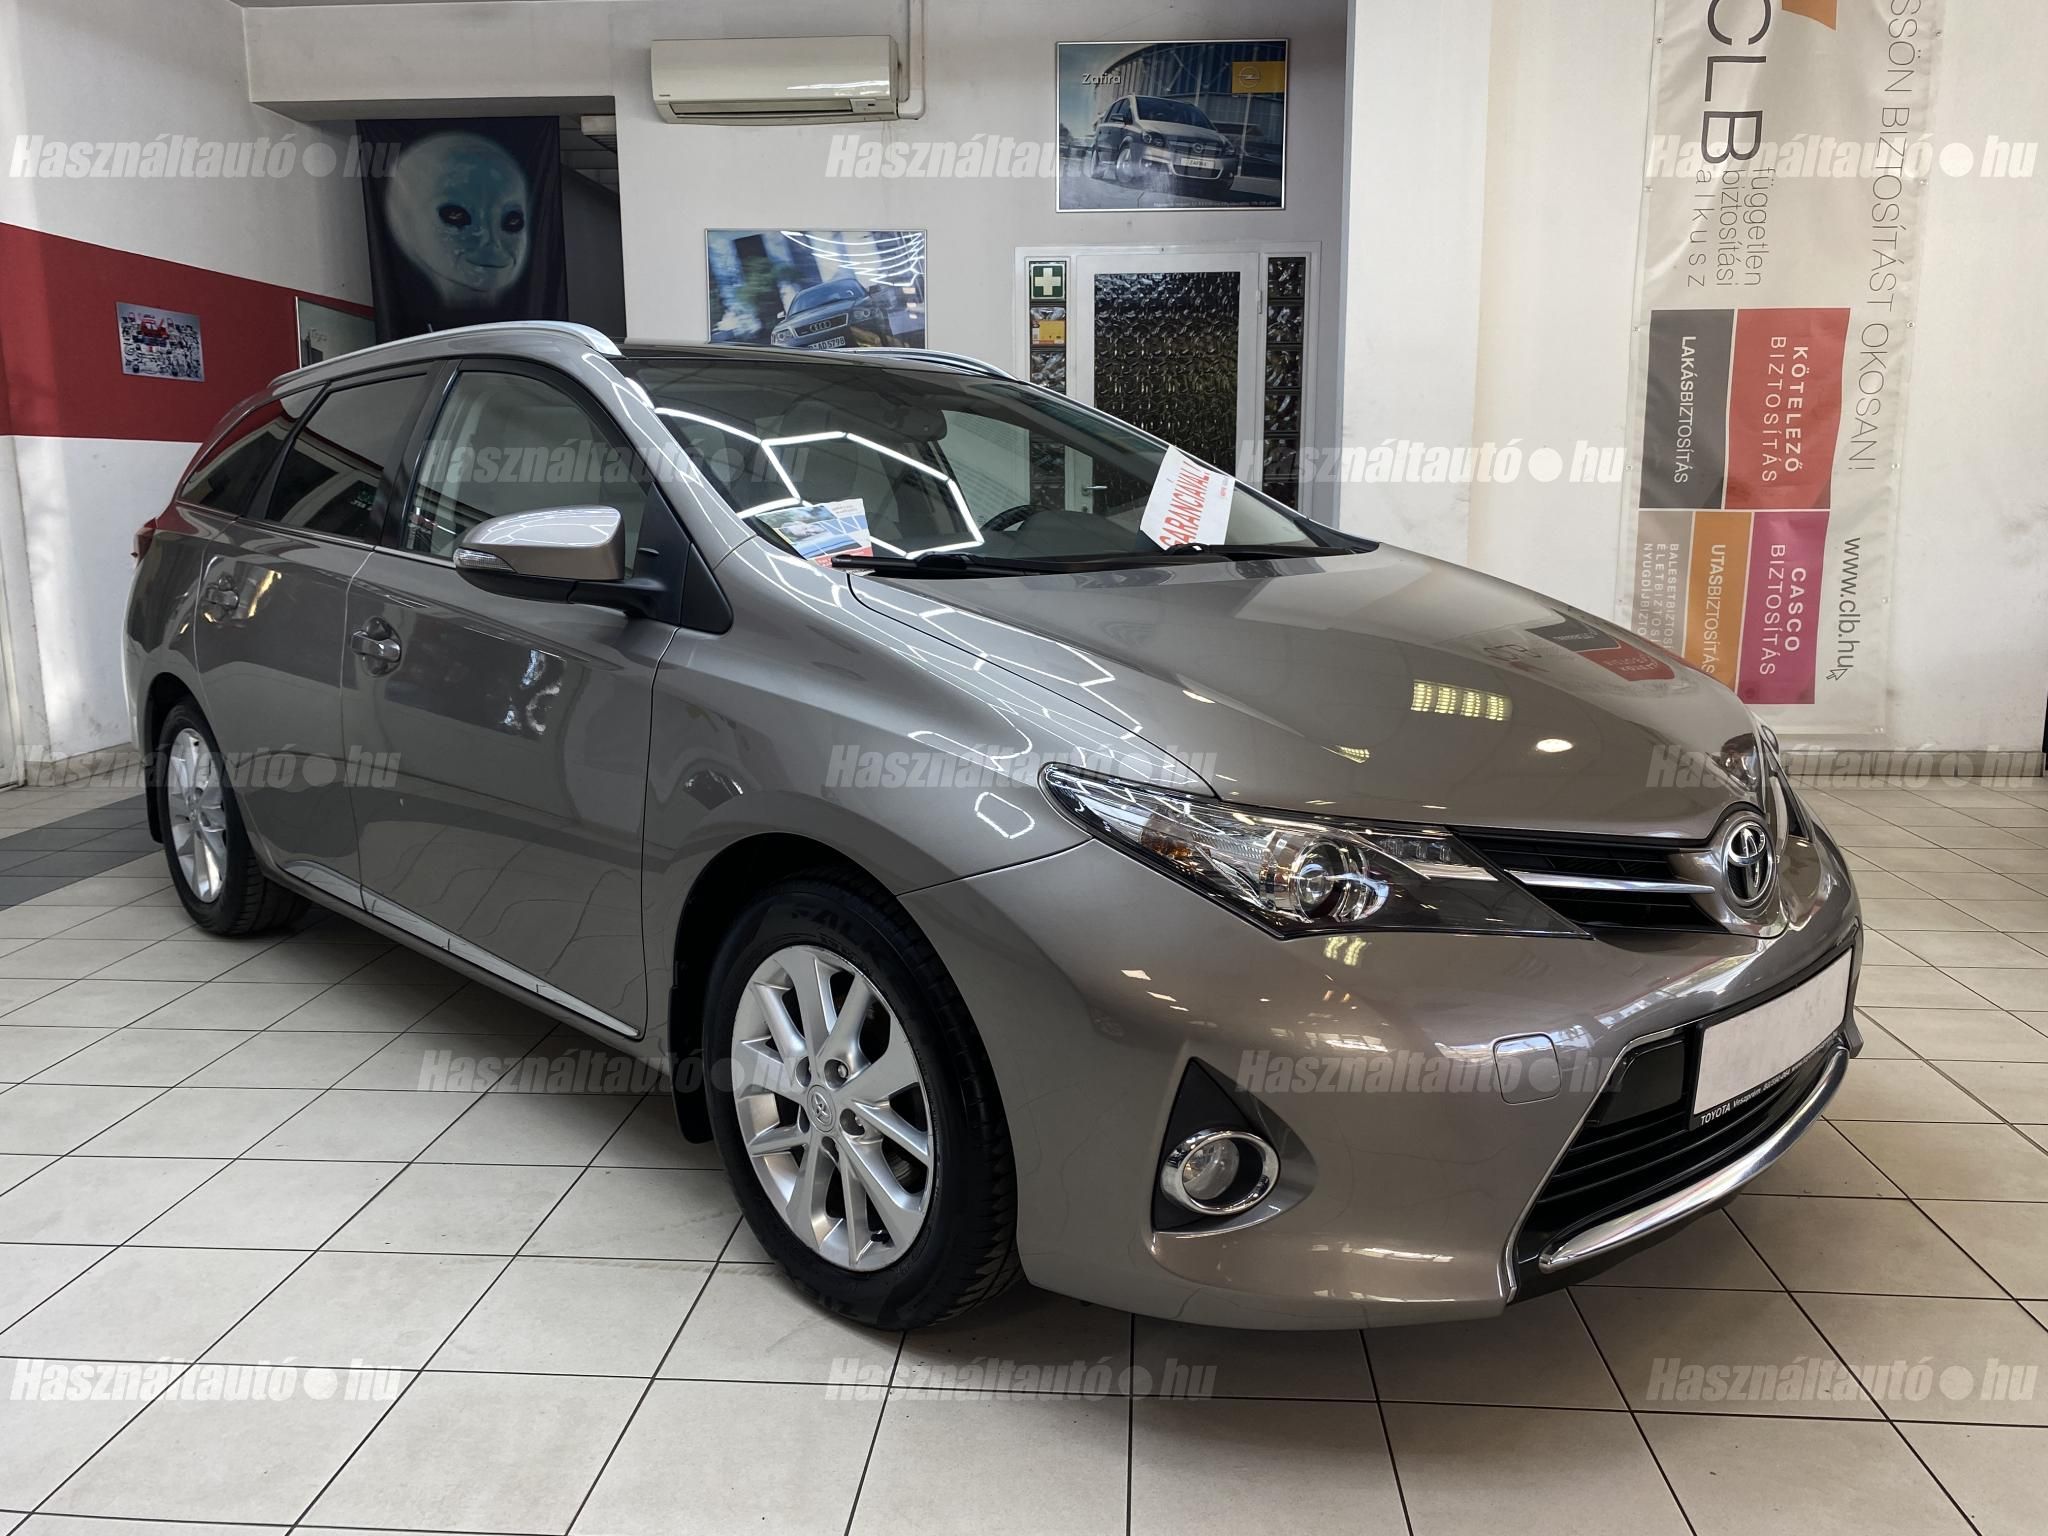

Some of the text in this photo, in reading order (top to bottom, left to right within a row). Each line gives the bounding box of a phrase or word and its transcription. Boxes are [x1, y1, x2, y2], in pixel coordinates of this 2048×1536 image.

[1082, 72, 1122, 85] Zafira
[1701, 0, 1772, 165] CLB
[1687, 169, 1716, 288] alkusz
[1716, 169, 1741, 287] biztosítási
[1744, 168, 1775, 286] független
[1867, 106, 1911, 312] BIZTOSÍTÁST
[1673, 335, 1698, 484] LAKÁSBIZTOSÍTÁS
[1760, 336, 1787, 483] BIZTOSÍTÁS
[1783, 346, 1809, 474] KÖTELEZŐ
[1849, 323, 1889, 471] OKOSAN!
[1638, 543, 1653, 636] NYUGDÍJBIZTO
[1651, 543, 1668, 643] ÉLETBIZTOSÍ
[1662, 543, 1679, 650] BALESETBIZTOSÍ
[1701, 544, 1726, 674] UTASBIZTOSÍTÁS
[1759, 544, 1786, 675] BIZTOSÍTÁS
[1784, 567, 1807, 651] CASCO
[1836, 537, 1861, 668] www.clb.hu
[1700, 1103, 1731, 1126] TOYOTA
